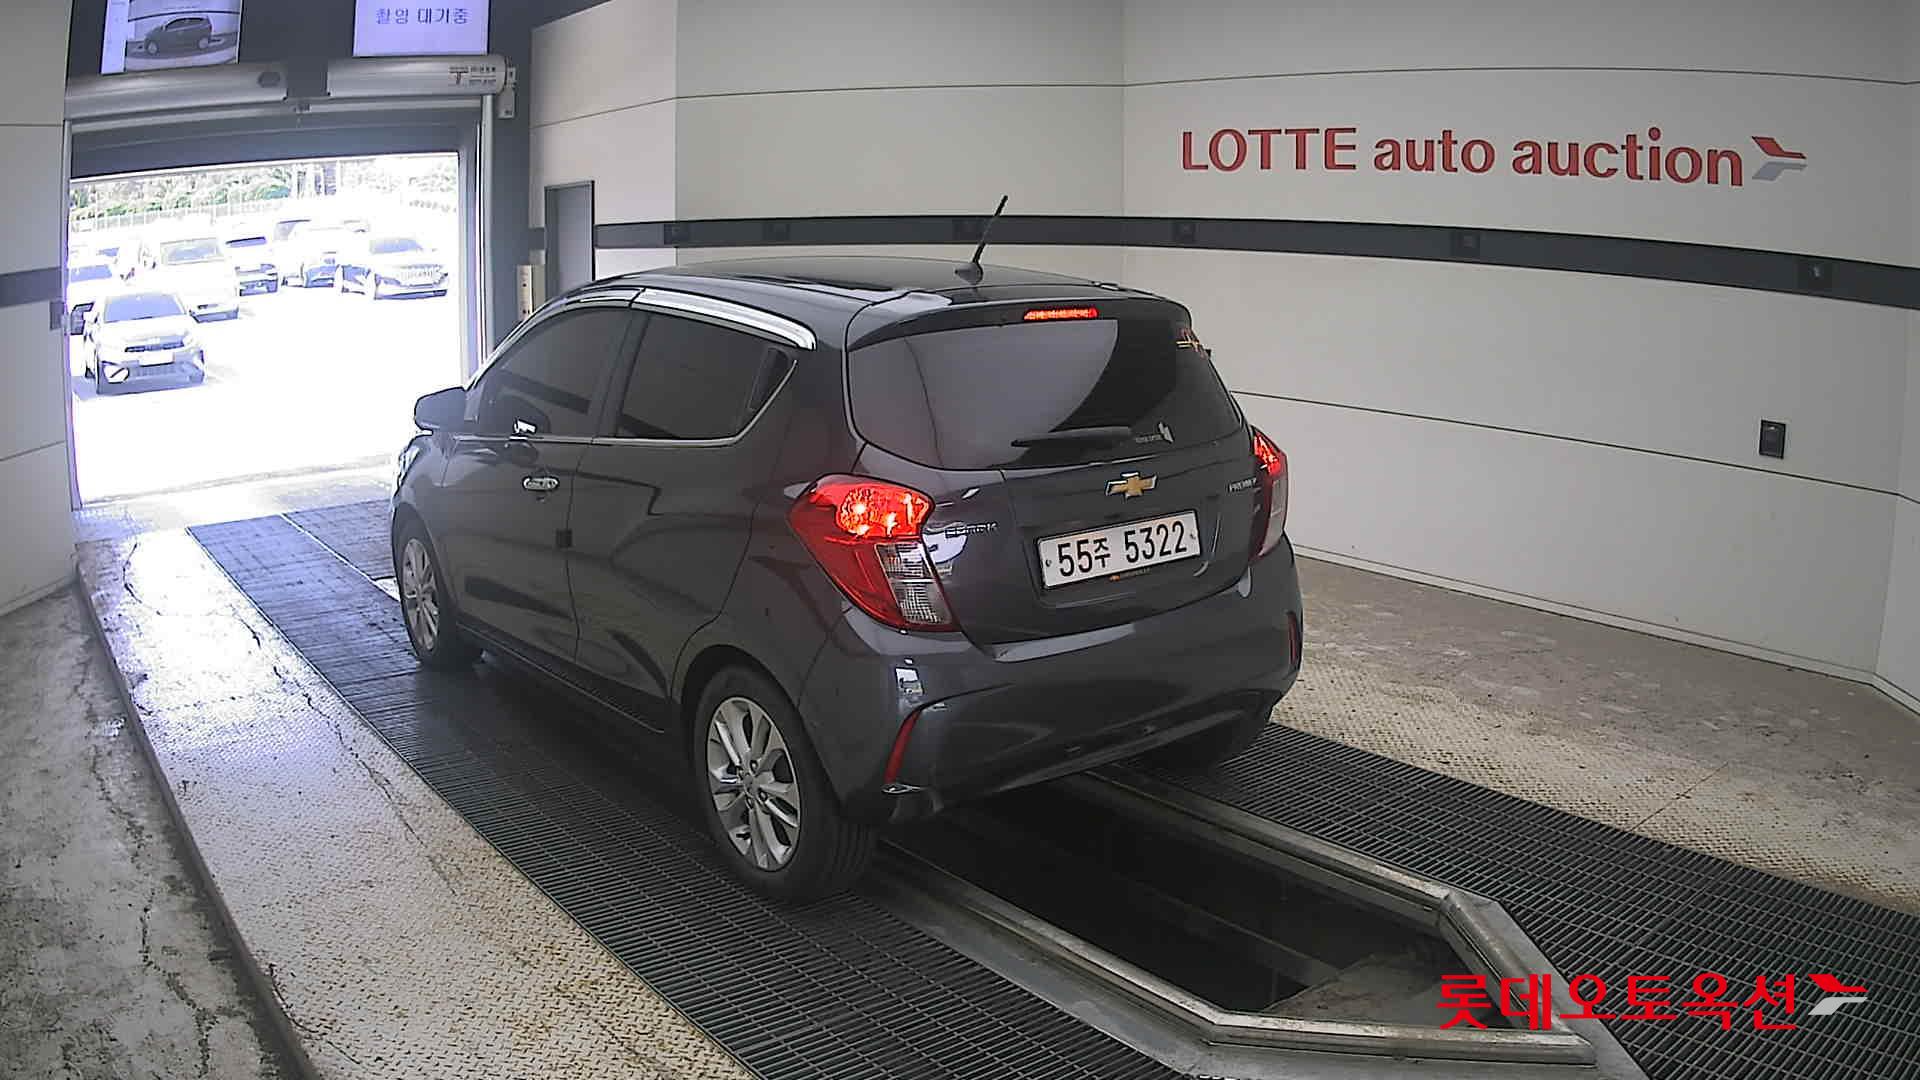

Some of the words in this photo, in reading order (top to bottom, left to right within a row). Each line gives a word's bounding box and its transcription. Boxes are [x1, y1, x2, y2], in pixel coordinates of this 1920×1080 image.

[417, 8, 468, 24] 대기중
[1182, 127, 1357, 171] LOTTE
[1373, 129, 1496, 173] auto
[1512, 127, 1744, 187] auction
[1057, 537, 1111, 577] 55주
[1123, 520, 1188, 563] 5322
